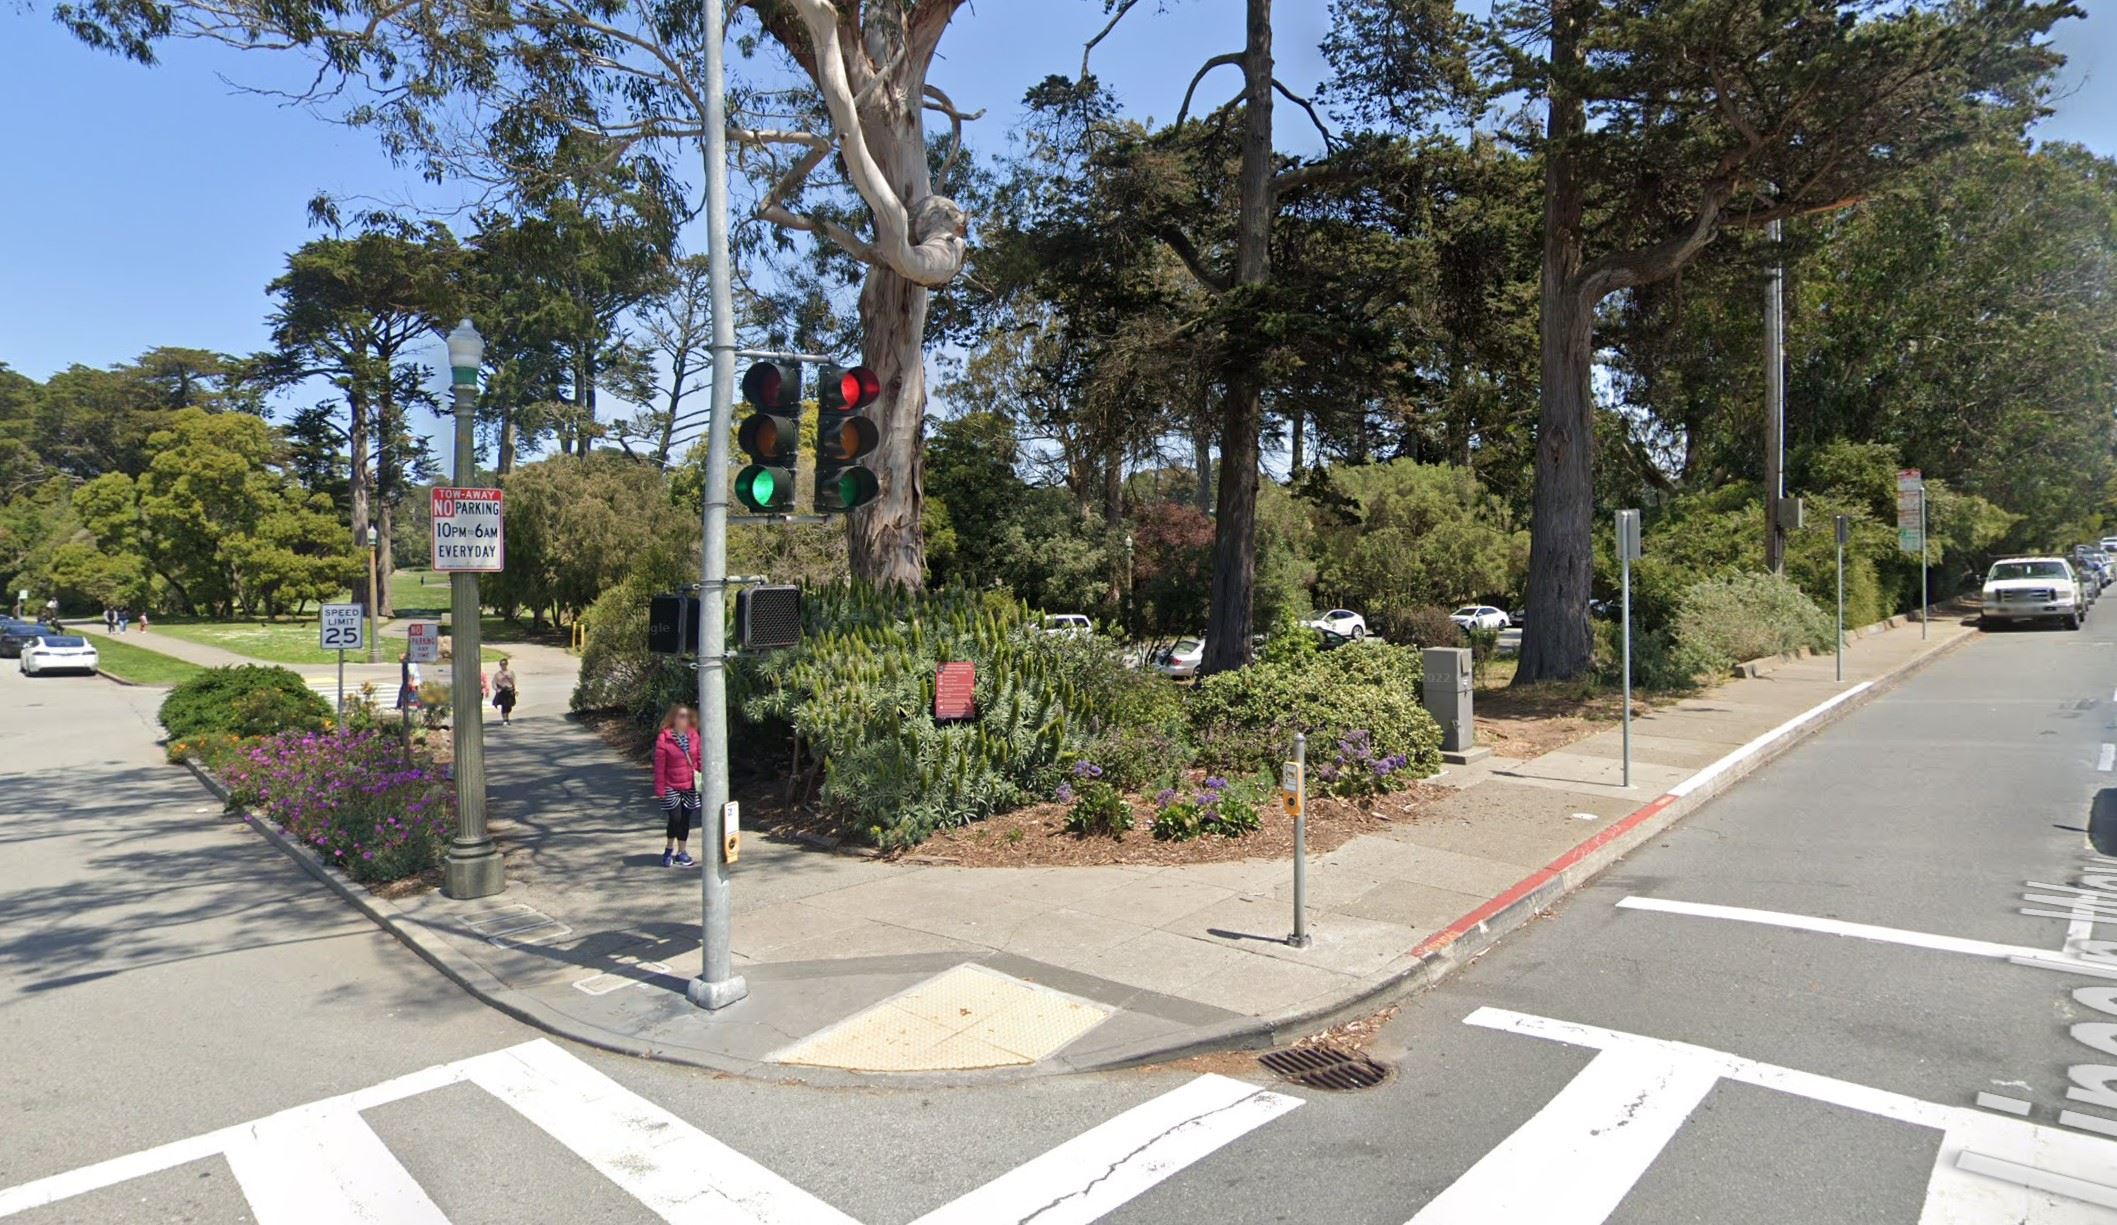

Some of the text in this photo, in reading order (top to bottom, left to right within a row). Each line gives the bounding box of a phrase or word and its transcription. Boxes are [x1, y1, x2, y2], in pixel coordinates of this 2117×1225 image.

[439, 489, 495, 499] TOW-AWAY
[434, 499, 499, 516] NO PARKING
[437, 522, 467, 538] 10PM
[475, 523, 498, 538] 6AM
[438, 545, 496, 558] EVERYDAY
[324, 609, 359, 617] SPEED
[328, 618, 355, 626] LIMIT
[325, 627, 358, 644] 25
[411, 626, 421, 635] NO
